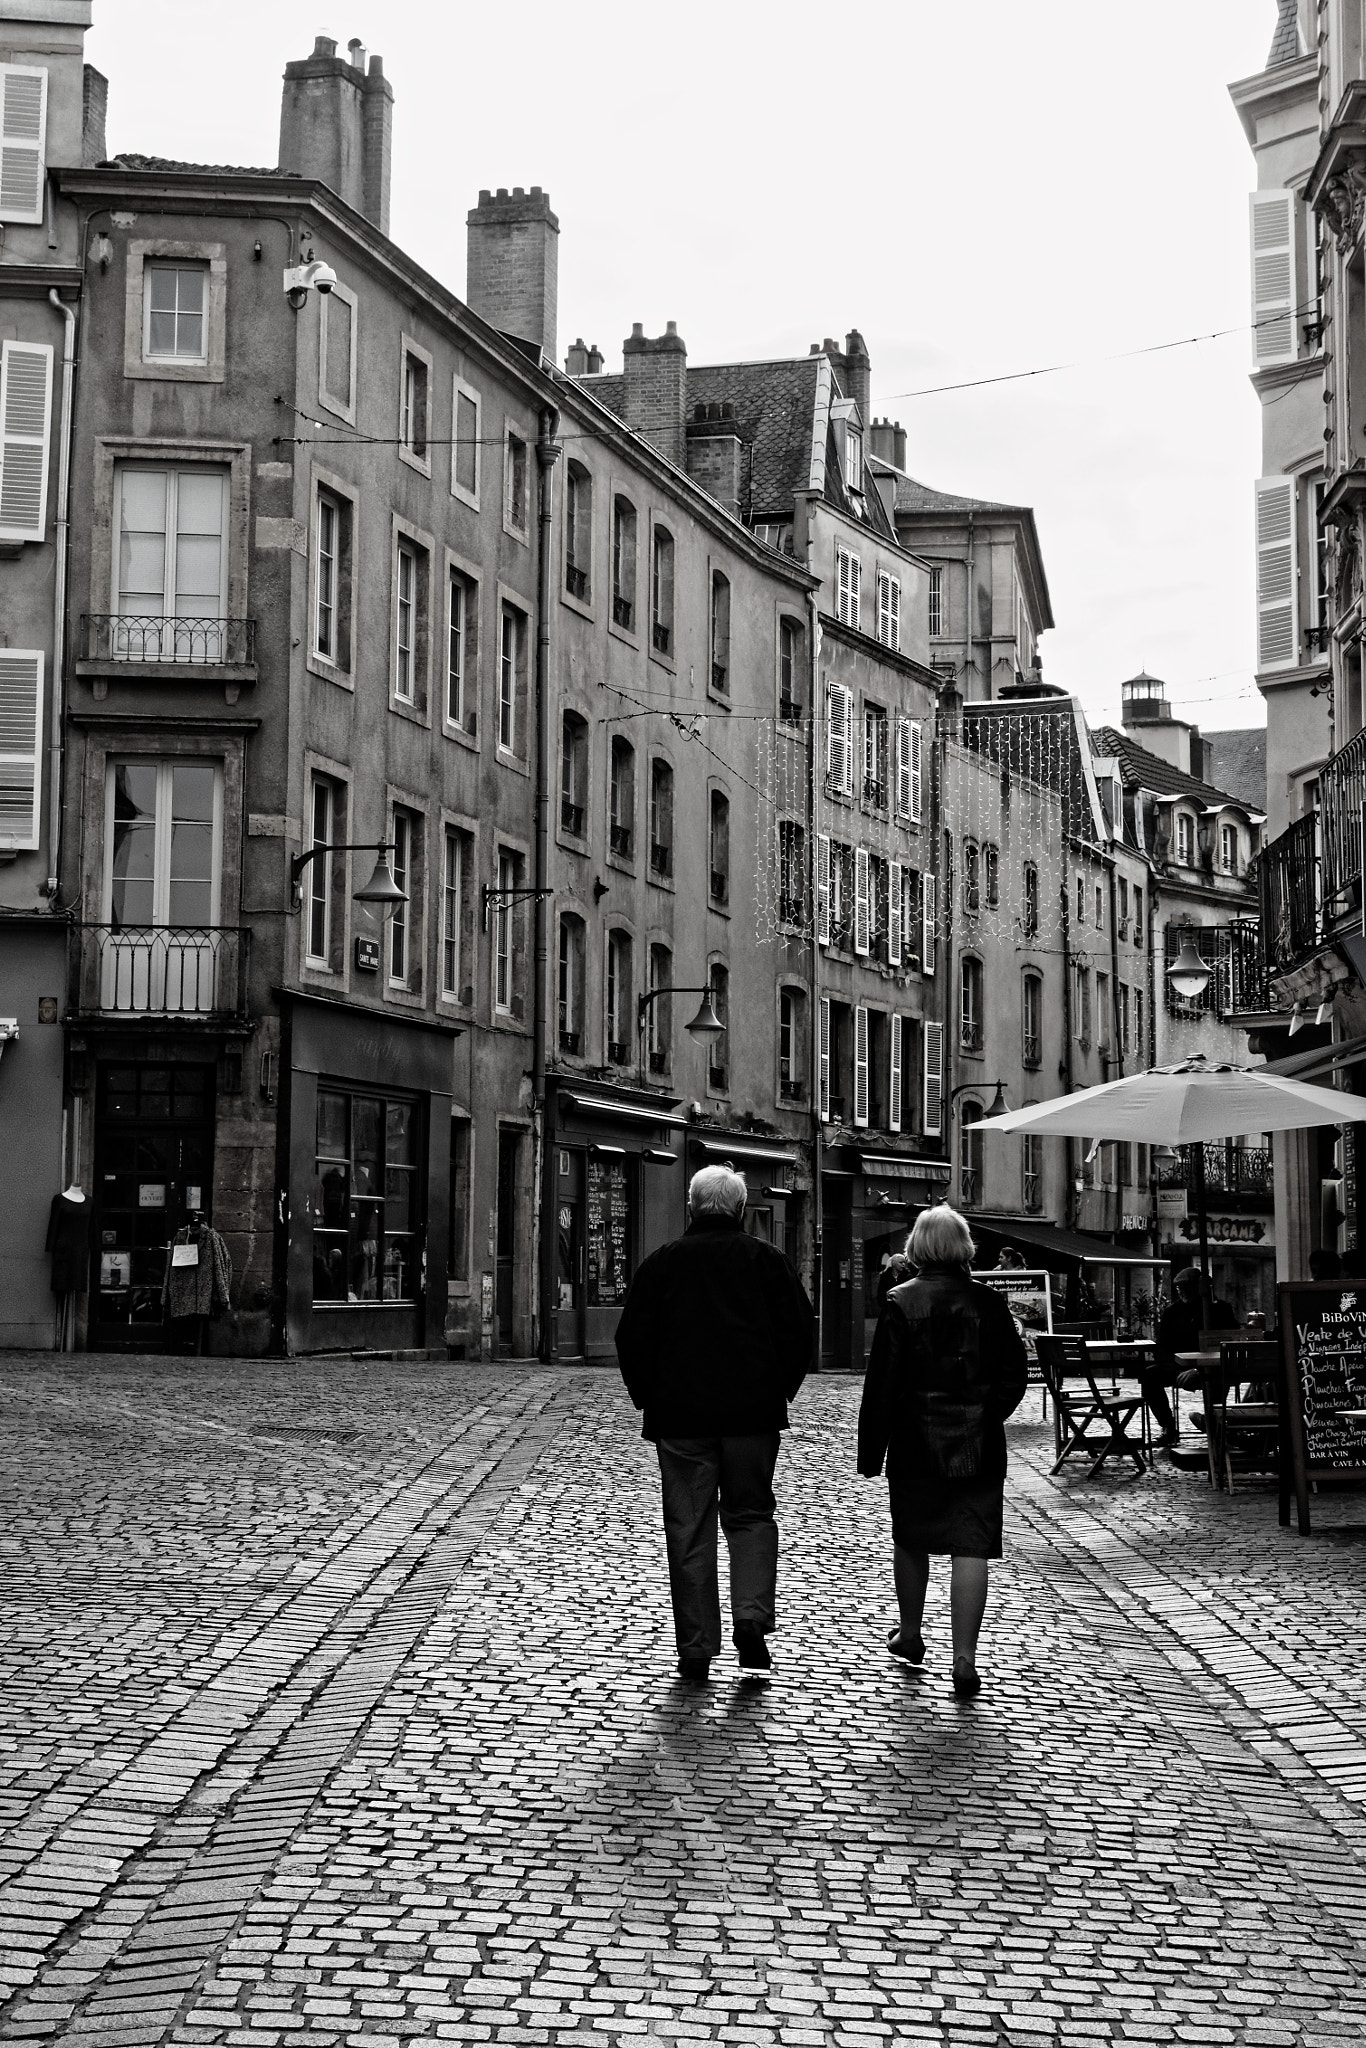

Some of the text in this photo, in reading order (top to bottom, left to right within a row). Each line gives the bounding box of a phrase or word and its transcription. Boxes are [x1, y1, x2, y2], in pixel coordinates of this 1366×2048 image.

[1190, 1220, 1256, 1239] SARGAME
[1295, 1322, 1333, 1345] Vente
[1337, 1327, 1354, 1340] de
[1298, 1345, 1308, 1357] de
[1309, 1449, 1349, 1459] BAR À VIN
[1332, 1460, 1353, 1468] CAVE
[1354, 1458, 1361, 1467] À
